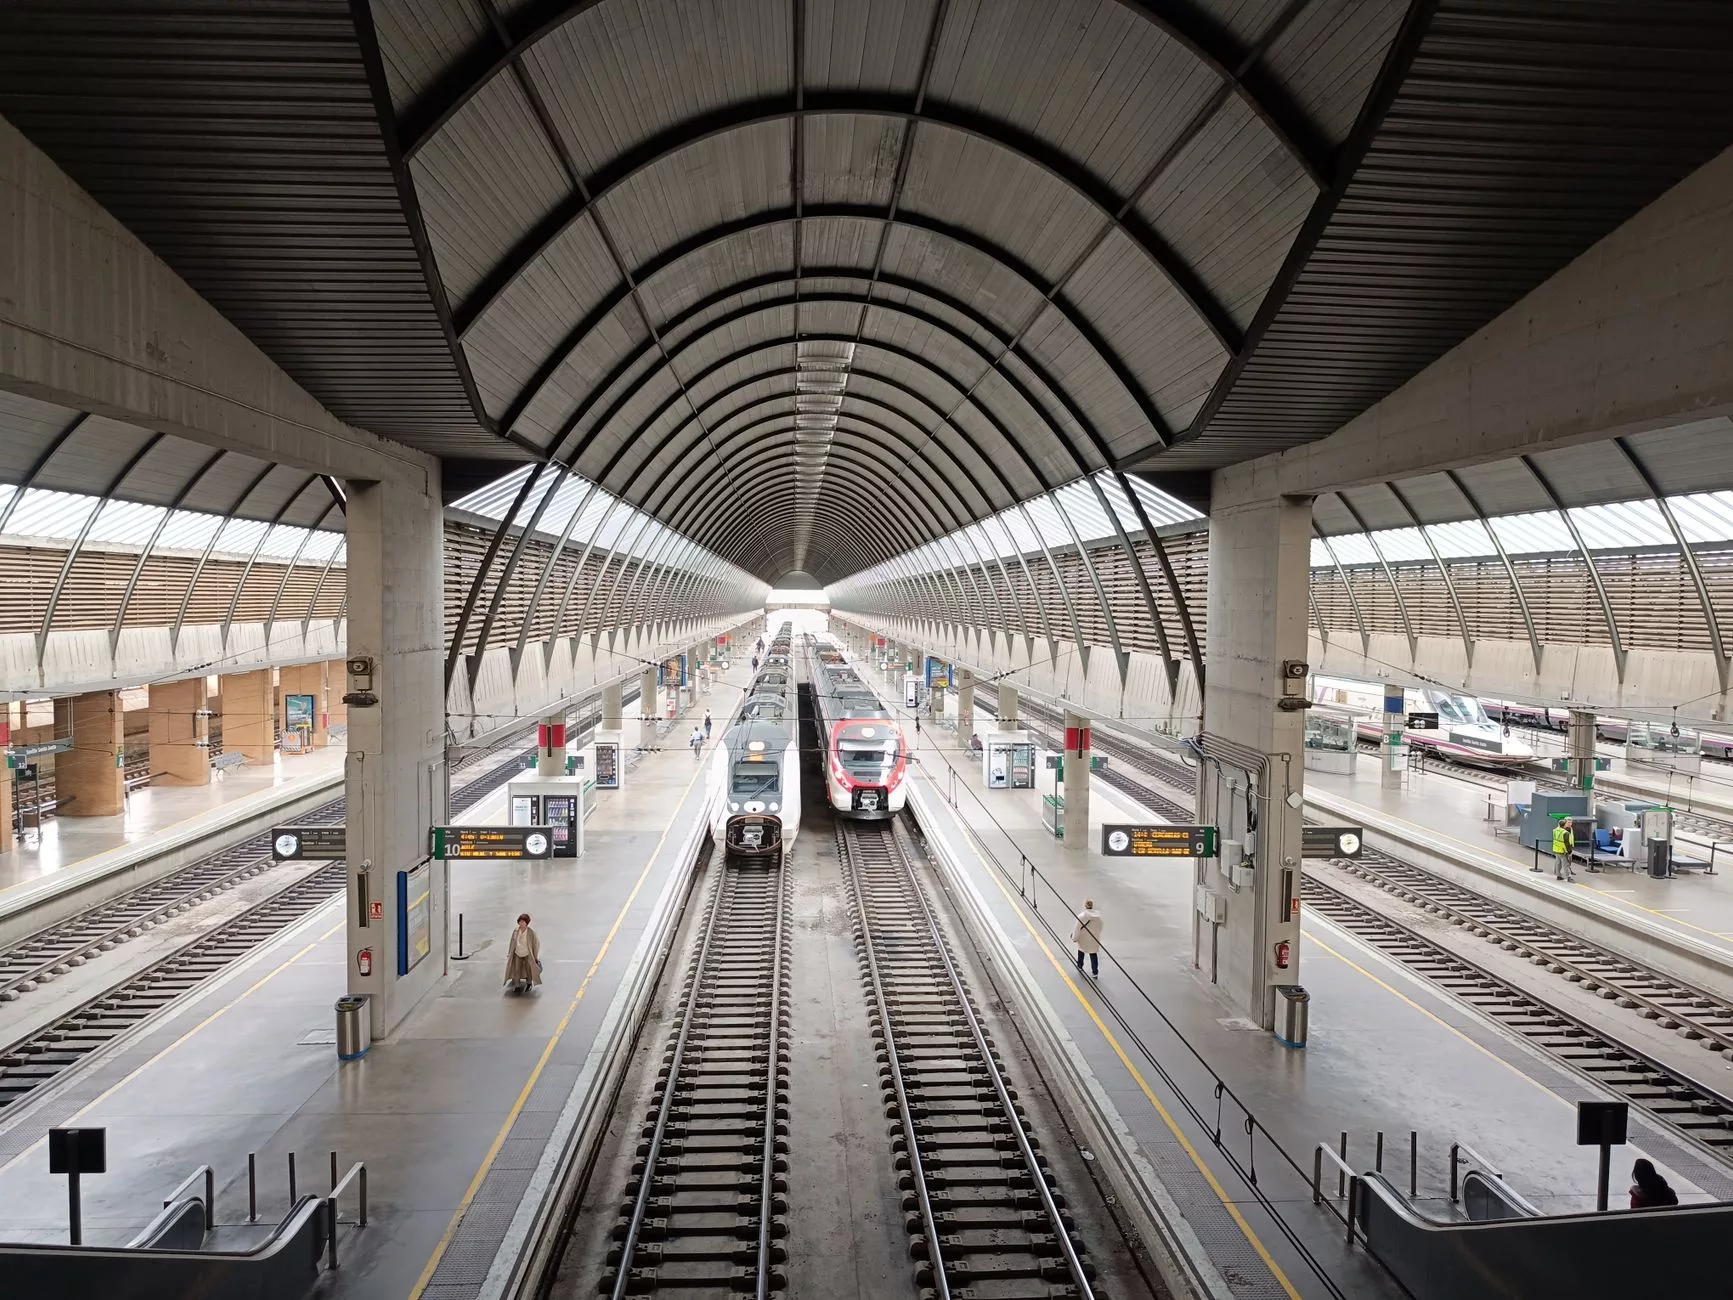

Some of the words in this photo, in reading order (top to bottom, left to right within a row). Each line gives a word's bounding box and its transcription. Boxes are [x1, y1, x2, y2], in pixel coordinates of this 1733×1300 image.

[1047, 761, 1052, 769] 9
[444, 843, 460, 857] 10
[1195, 842, 1204, 855] 9
